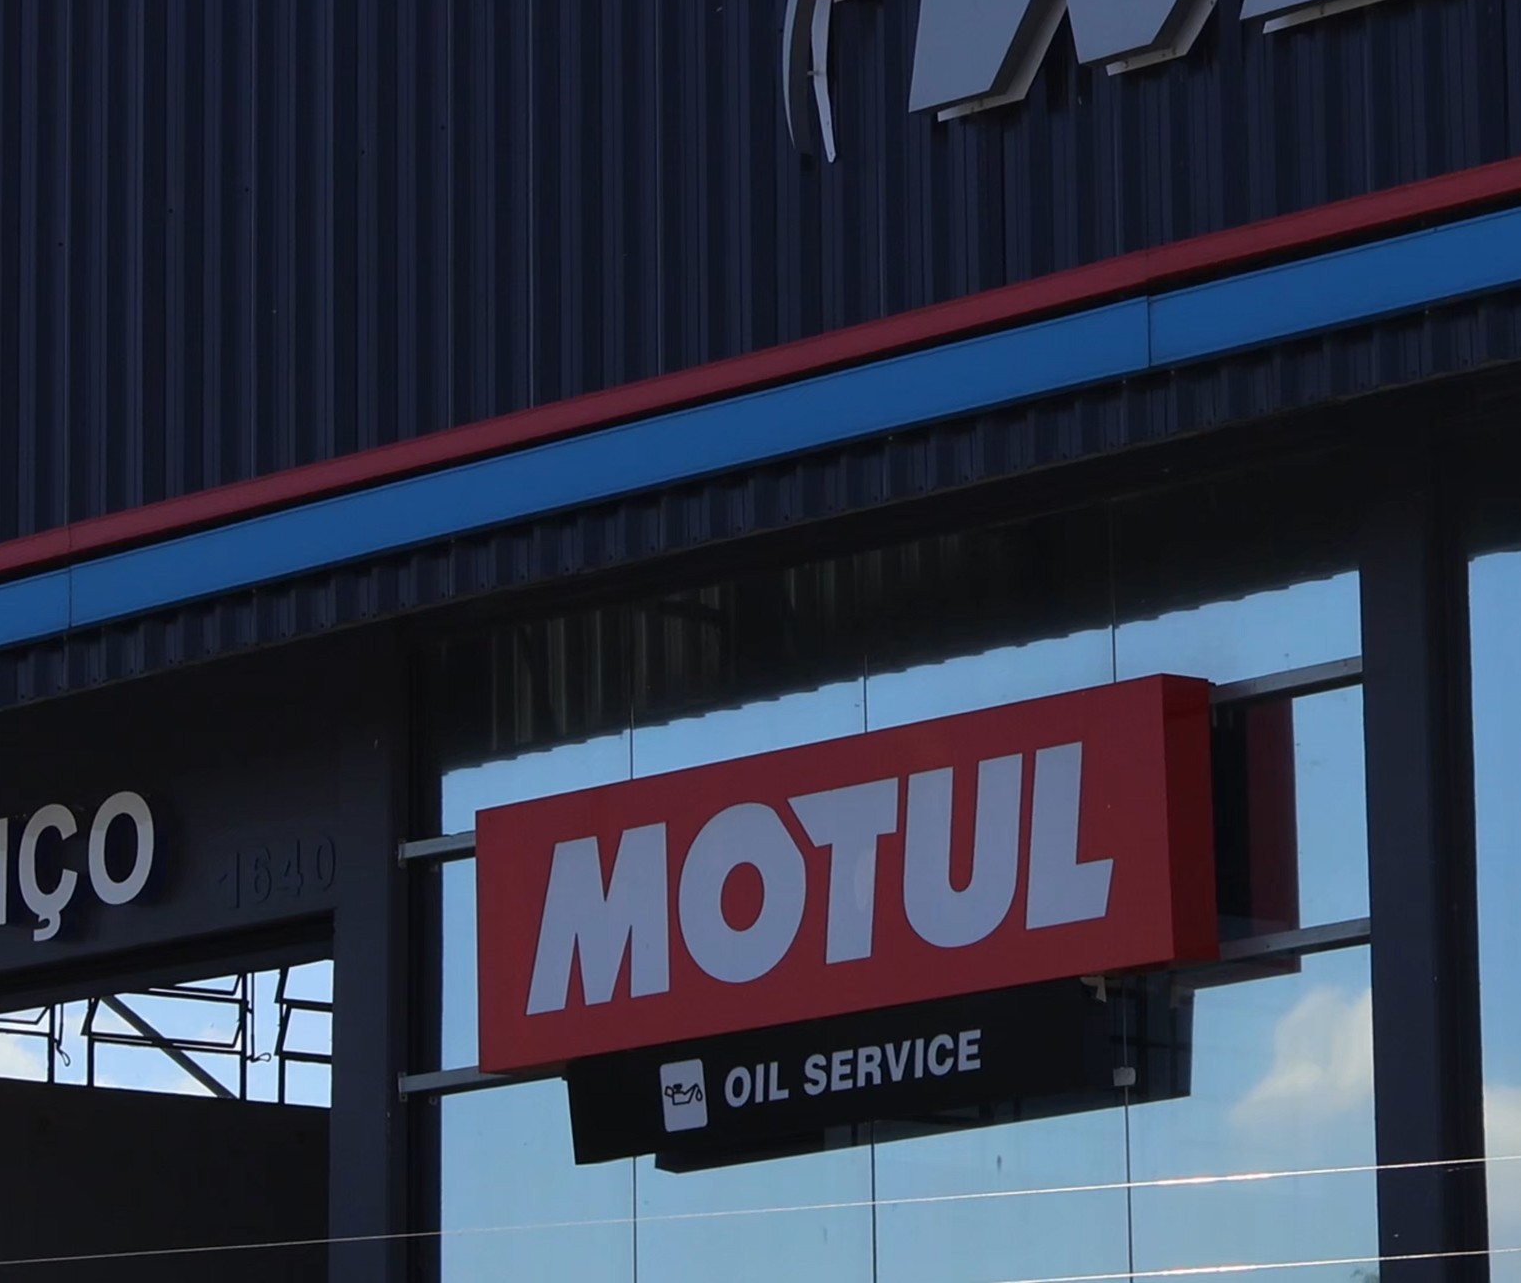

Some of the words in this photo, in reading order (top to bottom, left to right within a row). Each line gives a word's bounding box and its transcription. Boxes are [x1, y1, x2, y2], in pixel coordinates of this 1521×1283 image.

[216, 833, 337, 910] 1640
[526, 742, 1114, 1017] MOTUL
[724, 1061, 789, 1108] OIL
[803, 1029, 982, 1096] SERVICE
